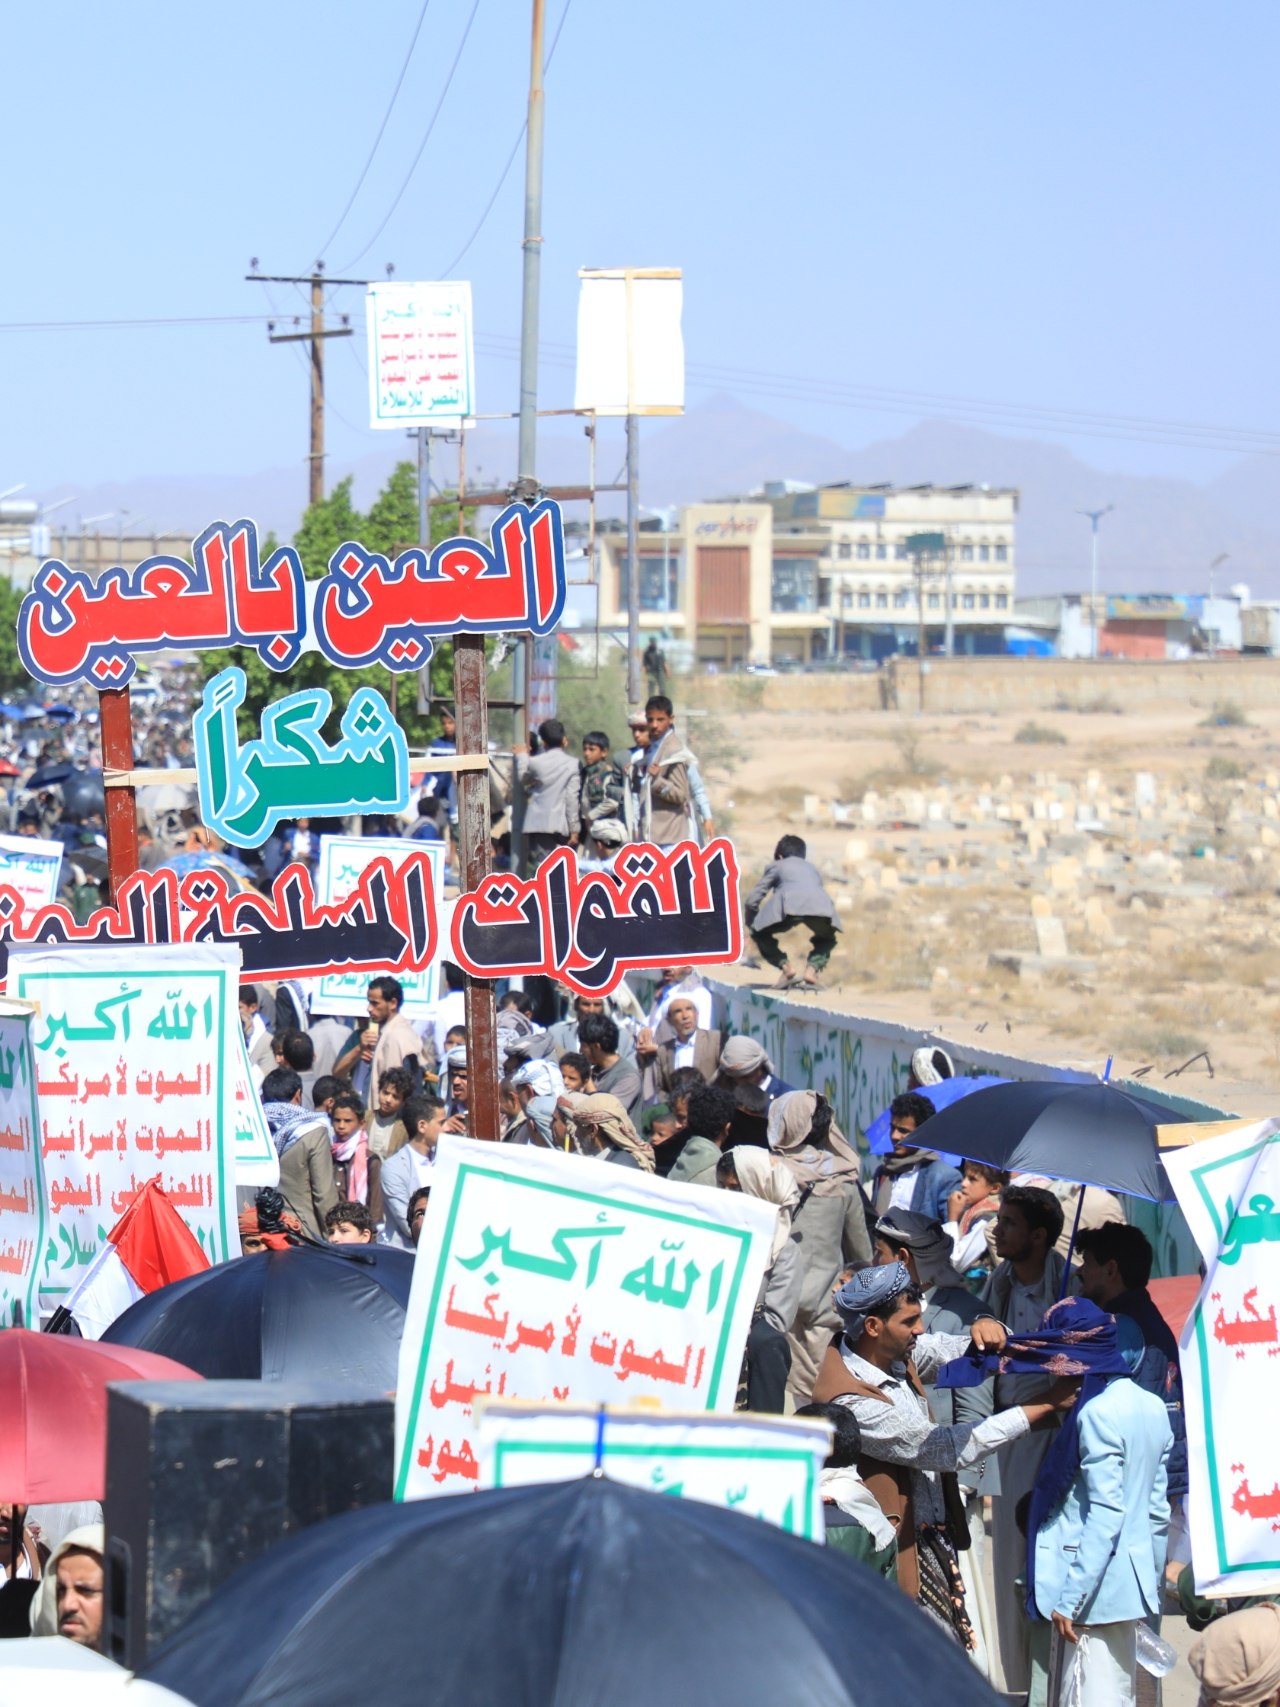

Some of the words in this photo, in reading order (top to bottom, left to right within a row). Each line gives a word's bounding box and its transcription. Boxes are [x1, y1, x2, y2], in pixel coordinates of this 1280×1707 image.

[28, 527, 298, 679] بالعين
[324, 509, 558, 663] العين
[191, 862, 427, 973] المسلحة
[460, 847, 732, 988] للقوات
[34, 982, 142, 1058] أكبر
[147, 988, 212, 1040] الله
[35, 1054, 128, 1104] لأمريكا
[136, 1062, 211, 1103] الموت
[42, 1116, 128, 1161] لإسرائيل
[135, 1118, 211, 1159] الموت
[51, 1172, 102, 1214] اليهو
[454, 1211, 626, 1290] أكبر
[620, 1239, 725, 1315] الله
[445, 1284, 582, 1356] لأمريكا
[590, 1330, 706, 1389] الموت
